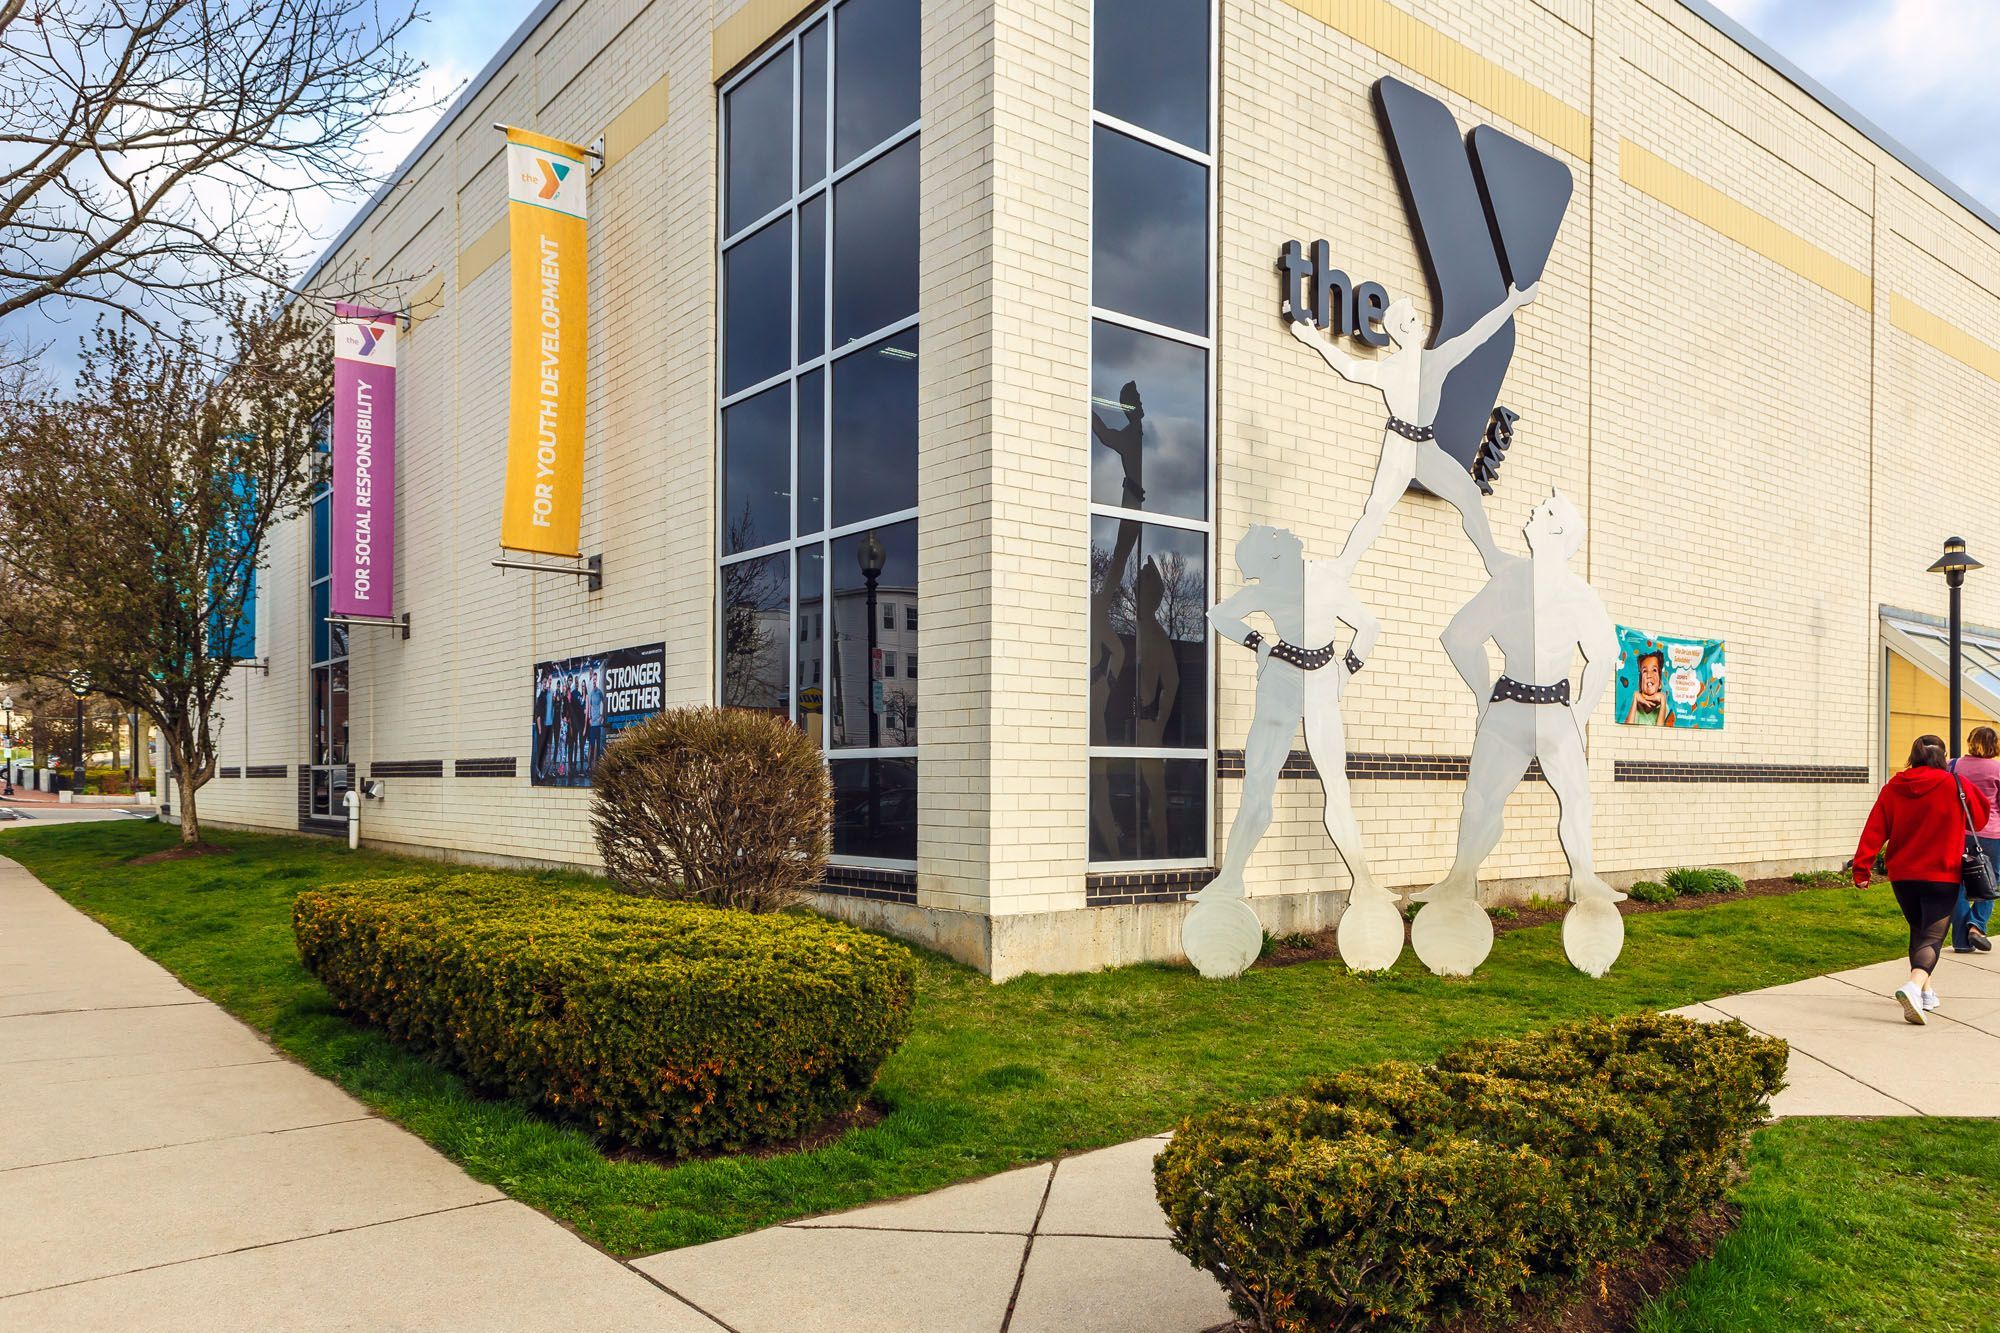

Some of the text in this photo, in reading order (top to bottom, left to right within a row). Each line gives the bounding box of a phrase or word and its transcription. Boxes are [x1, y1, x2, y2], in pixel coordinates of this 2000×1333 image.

[520, 172, 538, 185] the
[1278, 239, 1390, 347] the
[532, 234, 560, 527] FOR YOUTH DEVELOPMENT
[354, 379, 373, 601] FOR SOCIAL RESPONSIBILITY
[1473, 405, 1520, 498] YMCA
[605, 661, 661, 690] STRONGER
[605, 687, 661, 713] TOGETHER
